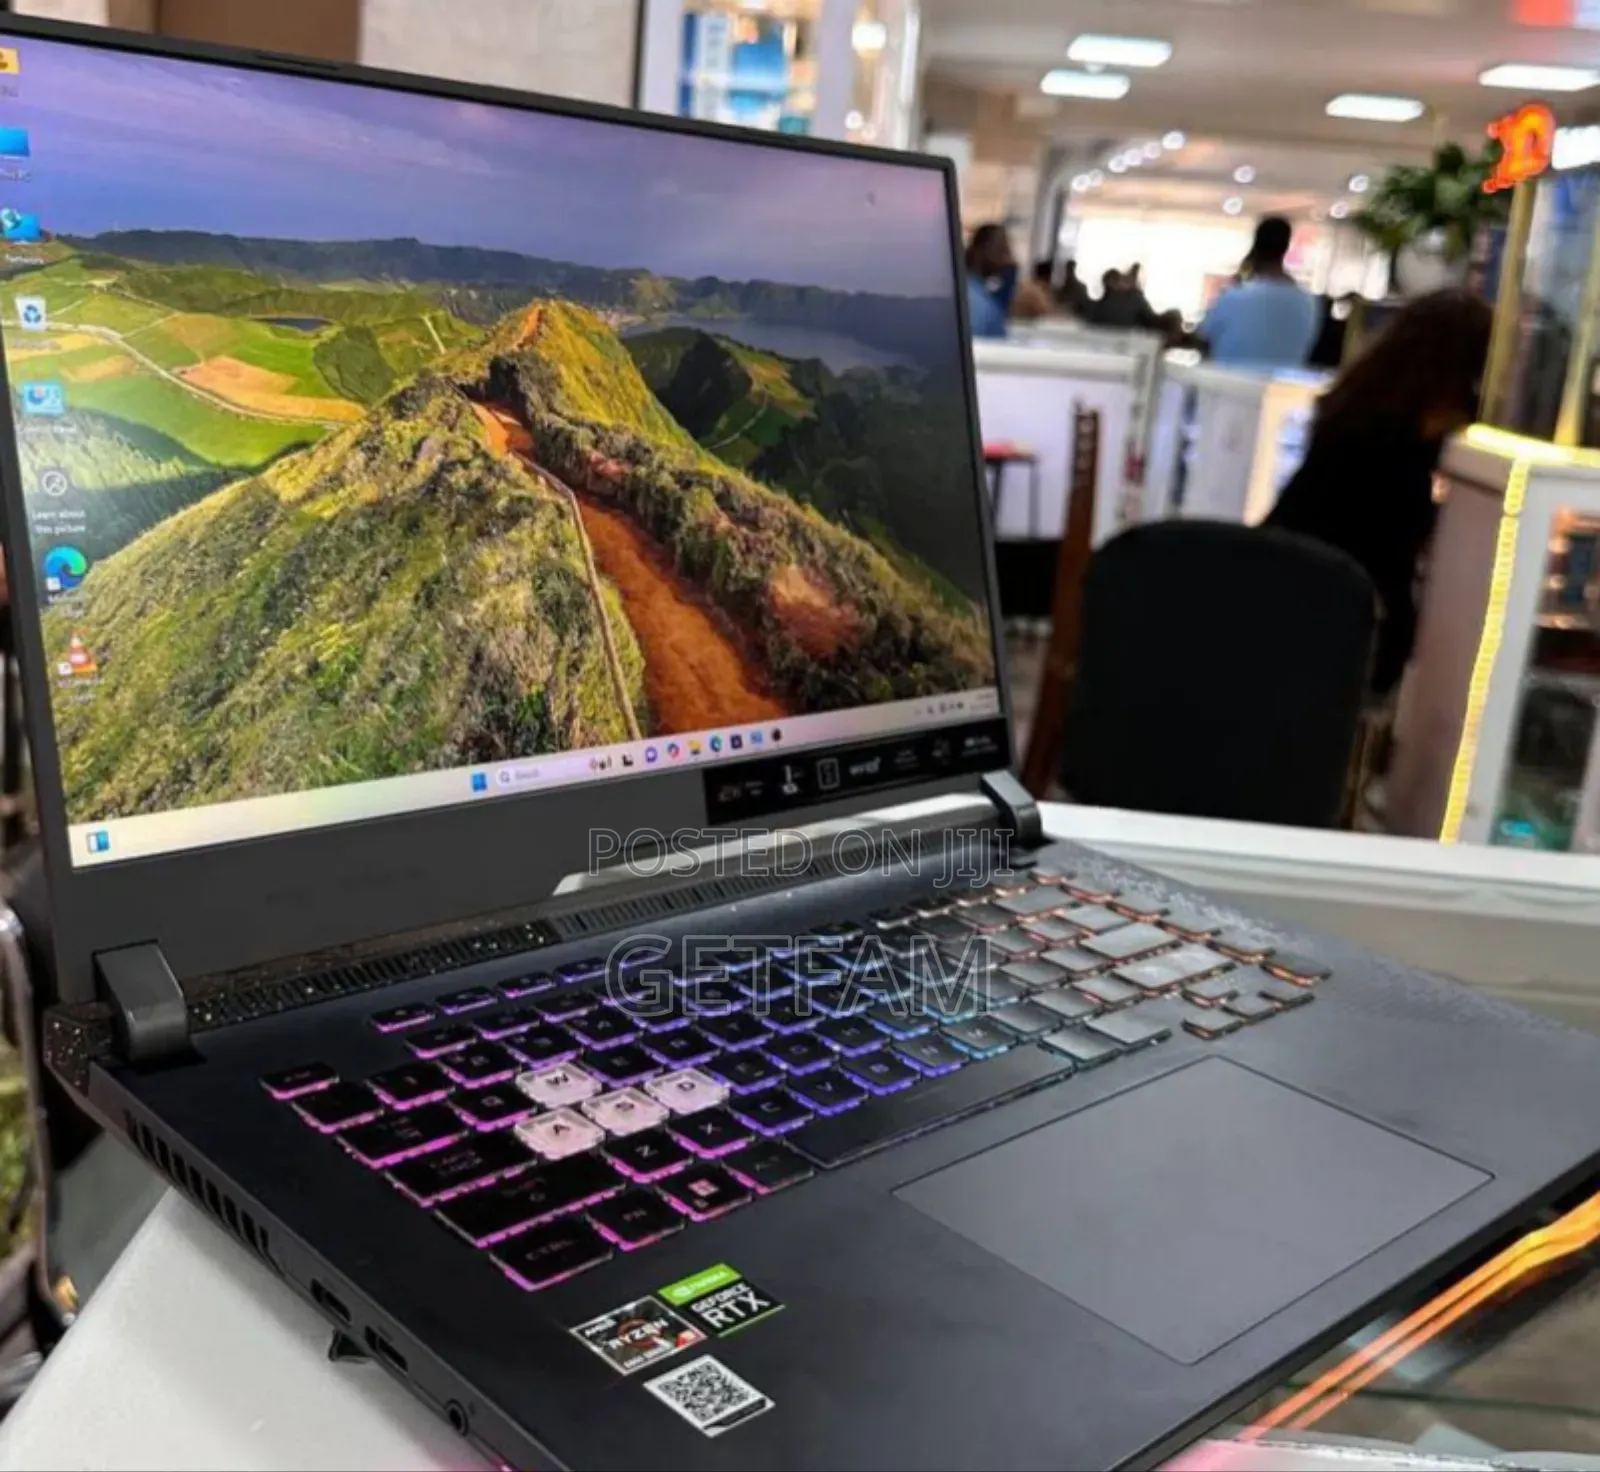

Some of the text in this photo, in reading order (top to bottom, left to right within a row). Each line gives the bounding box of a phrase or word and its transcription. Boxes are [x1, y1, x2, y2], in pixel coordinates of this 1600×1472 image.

[546, 1072, 569, 1085] W
[677, 1080, 696, 1092] D
[553, 1123, 570, 1137] A
[698, 1121, 722, 1136] X
[634, 1143, 659, 1159] Z
[701, 1289, 771, 1329] RTX
[607, 1317, 670, 1350] RYZEN
